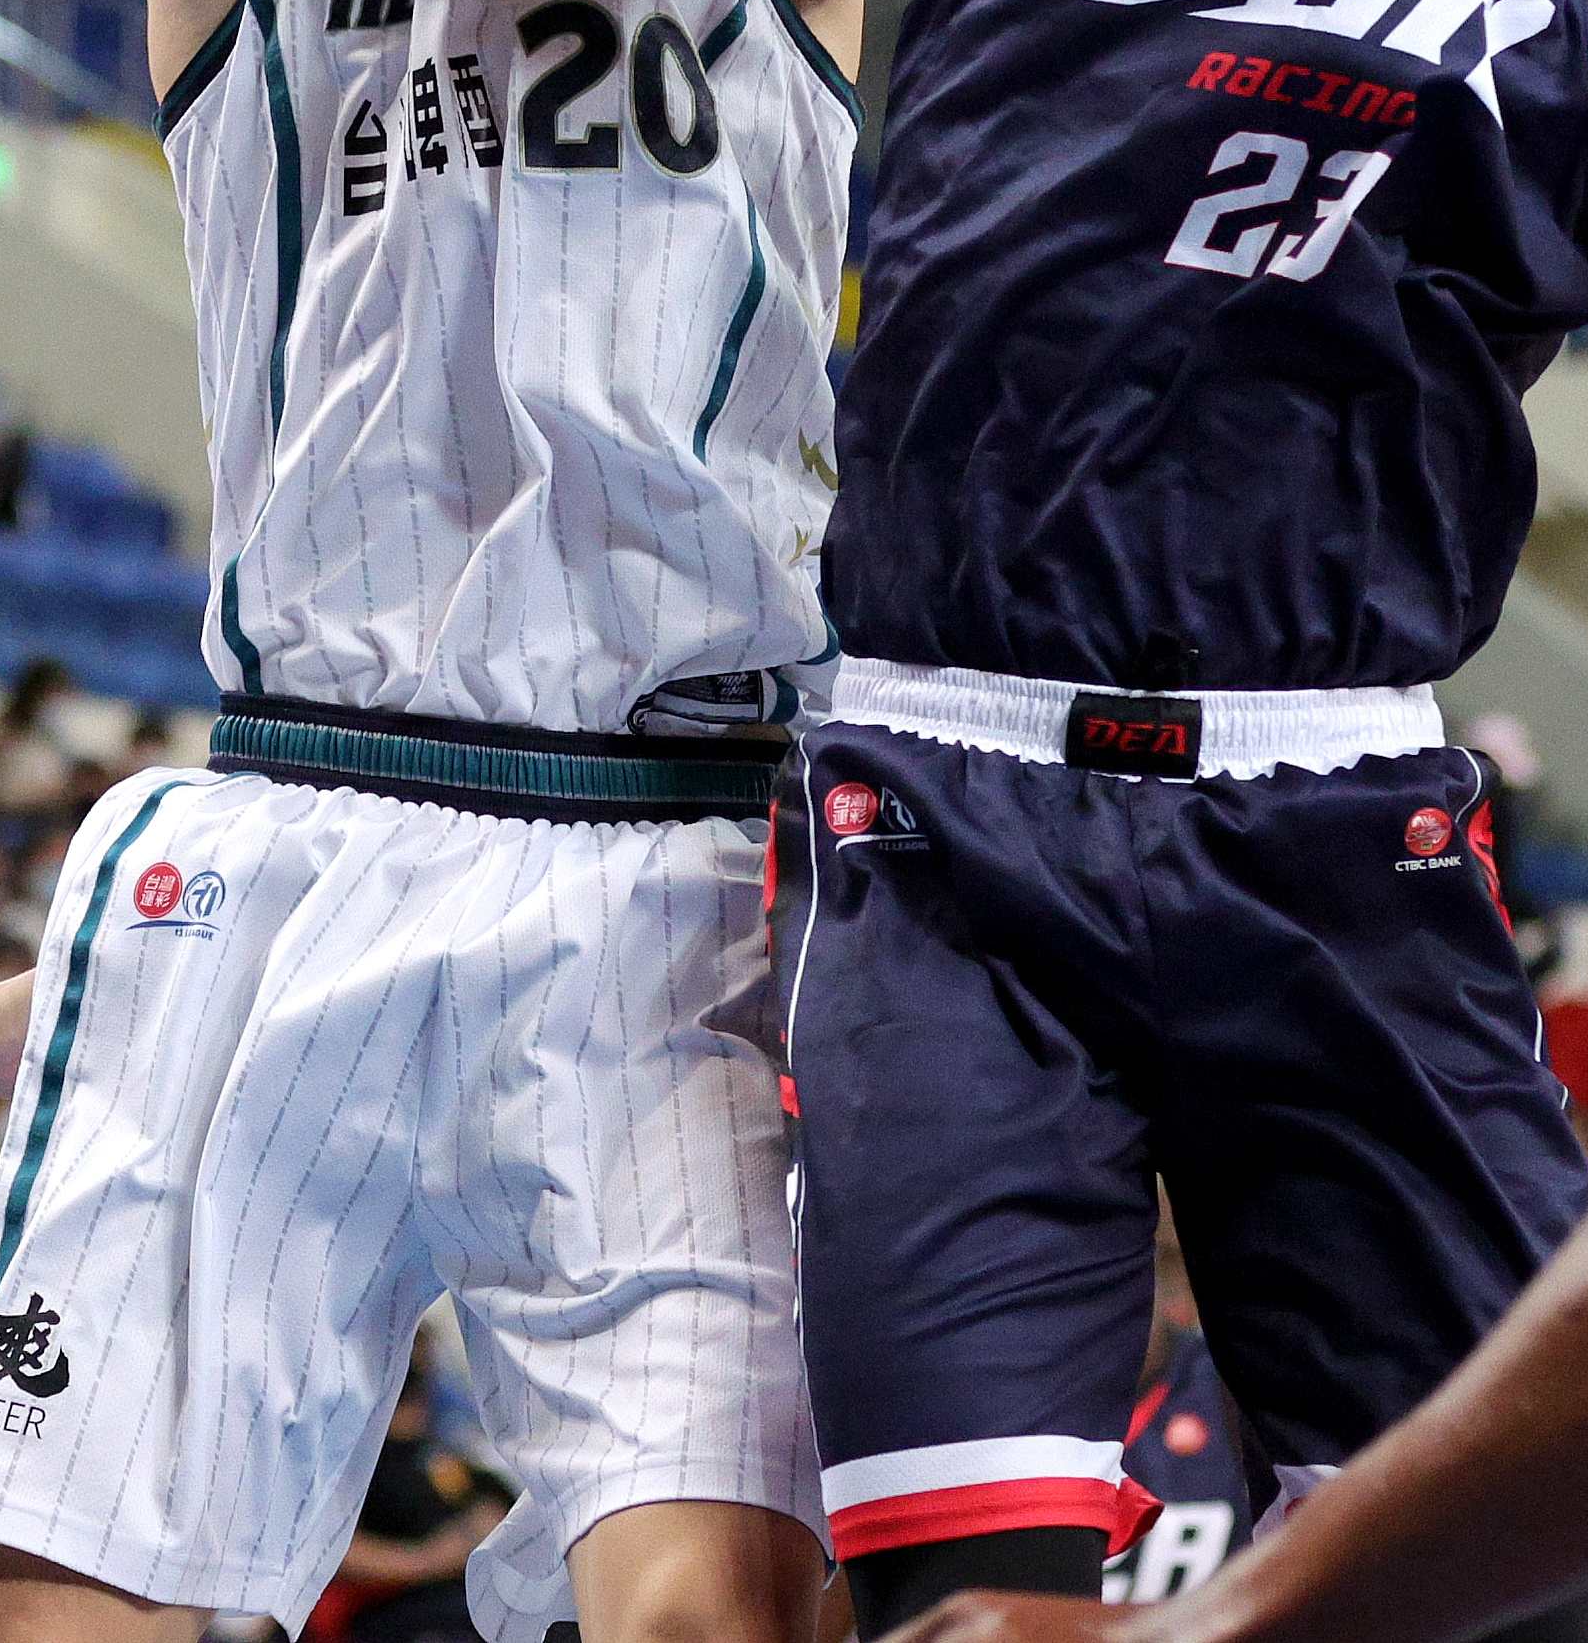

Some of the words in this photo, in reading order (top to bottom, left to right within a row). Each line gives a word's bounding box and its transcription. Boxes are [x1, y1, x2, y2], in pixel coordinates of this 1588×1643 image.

[1163, 131, 1393, 283] 23
[1082, 715, 1188, 756] DEA
[1394, 859, 1427, 872] CTBC
[1428, 855, 1463, 869] BANK
